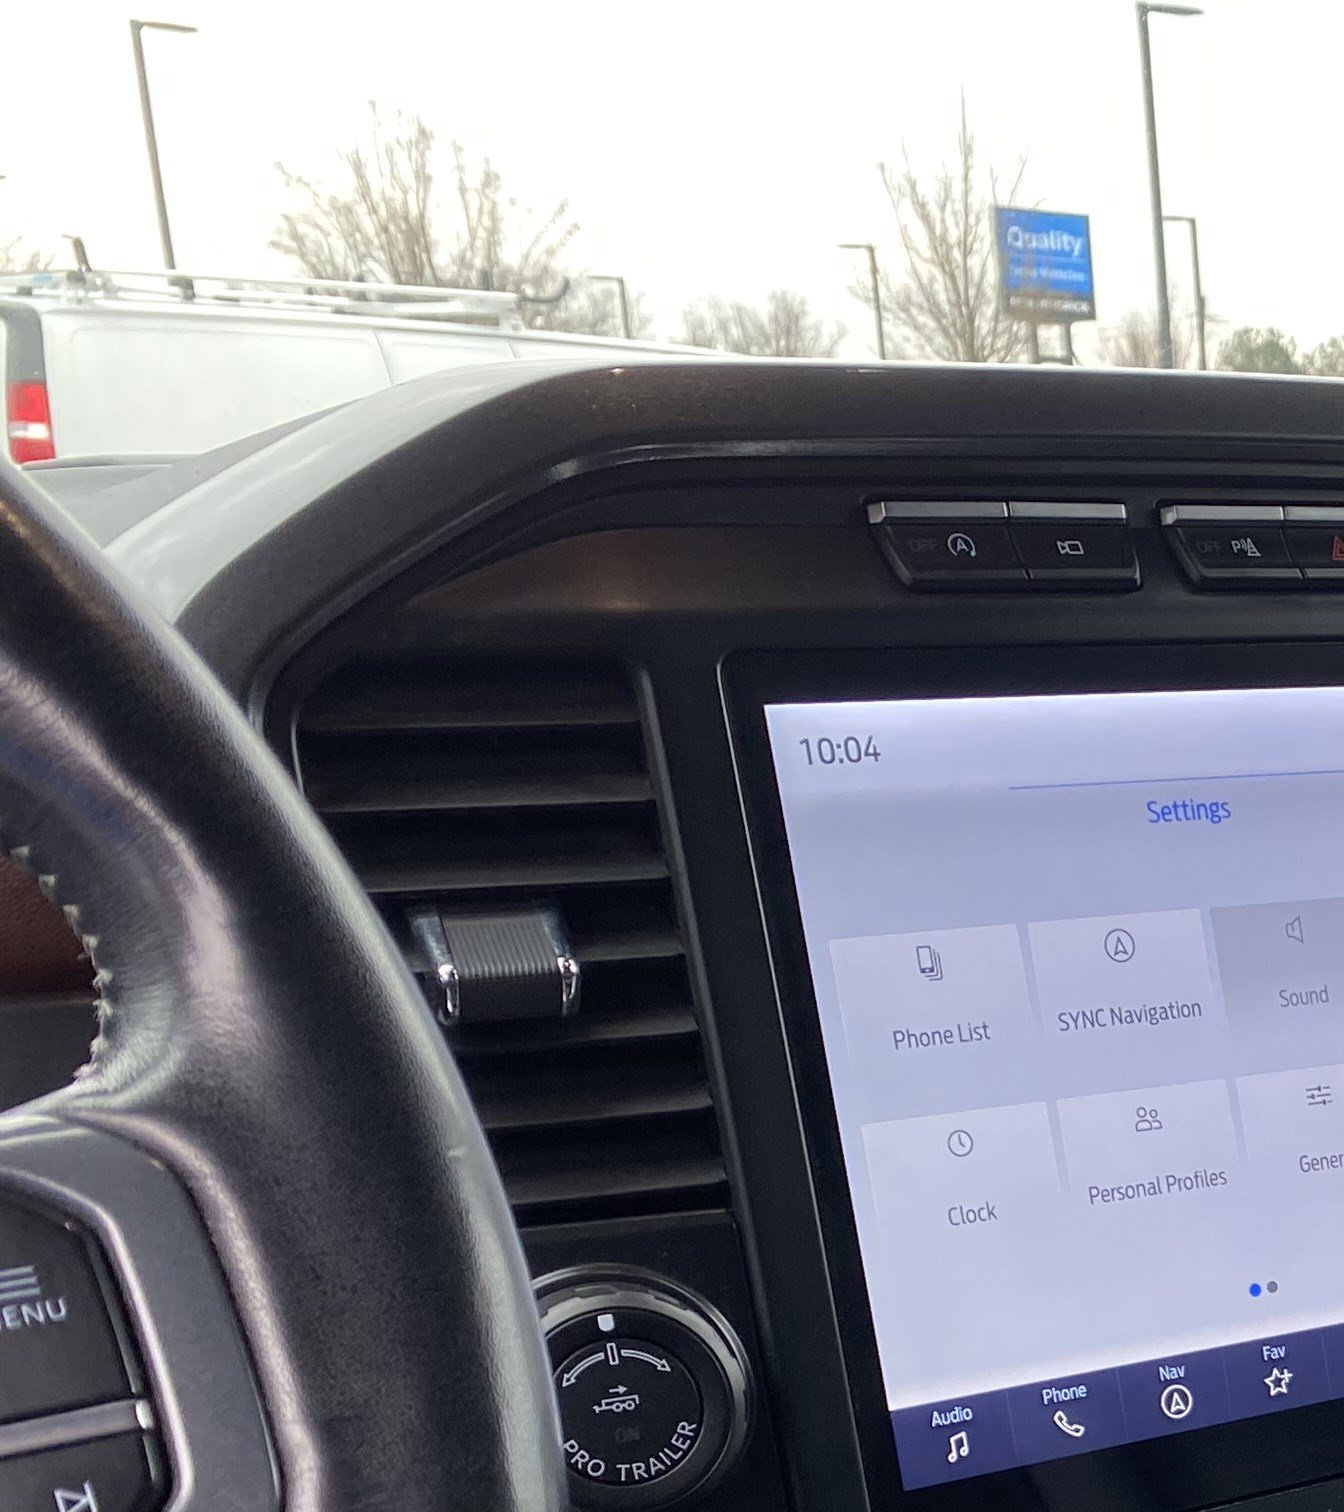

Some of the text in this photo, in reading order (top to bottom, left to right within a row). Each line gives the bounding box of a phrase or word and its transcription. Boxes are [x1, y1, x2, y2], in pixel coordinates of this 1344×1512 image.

[1008, 225, 1082, 256] Quality
[799, 735, 881, 766] 10:04
[1146, 799, 1231, 825] Settings
[1279, 986, 1329, 1008] Sound
[1058, 999, 1202, 1033] SYNC Navigation
[893, 1021, 991, 1050] Phone List
[1088, 1168, 1228, 1205] Personal Profiles
[947, 1201, 998, 1227] Clock
[0, 1297, 67, 1330] ENU
[1262, 1343, 1286, 1361] Fav
[1158, 1363, 1186, 1382] Nav
[1042, 1382, 1088, 1406] Phone
[931, 1404, 974, 1428] Audio
[563, 1420, 697, 1481] PRO TRAILER
